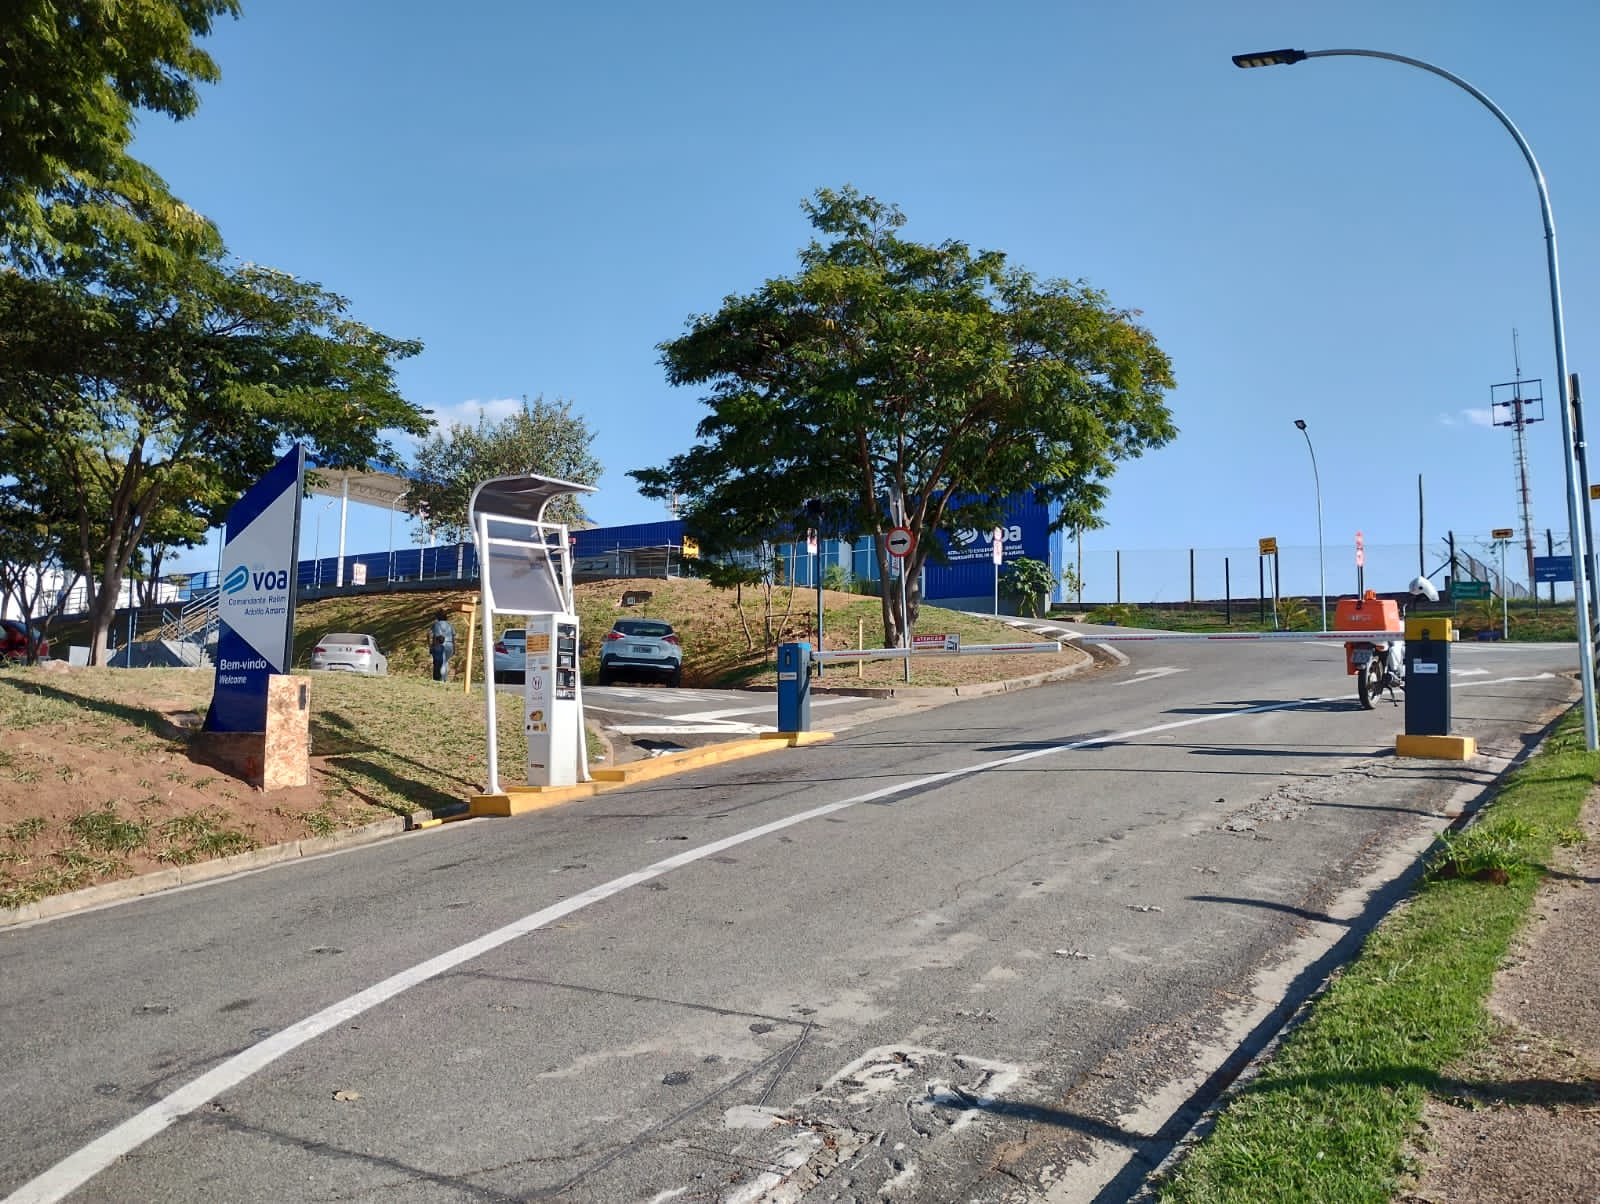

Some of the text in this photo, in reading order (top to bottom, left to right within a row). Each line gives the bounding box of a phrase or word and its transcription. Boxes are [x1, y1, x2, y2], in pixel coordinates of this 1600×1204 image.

[253, 570, 288, 591] voa
[220, 659, 267, 670] Bem-vindo
[219, 675, 247, 684] Welcome
